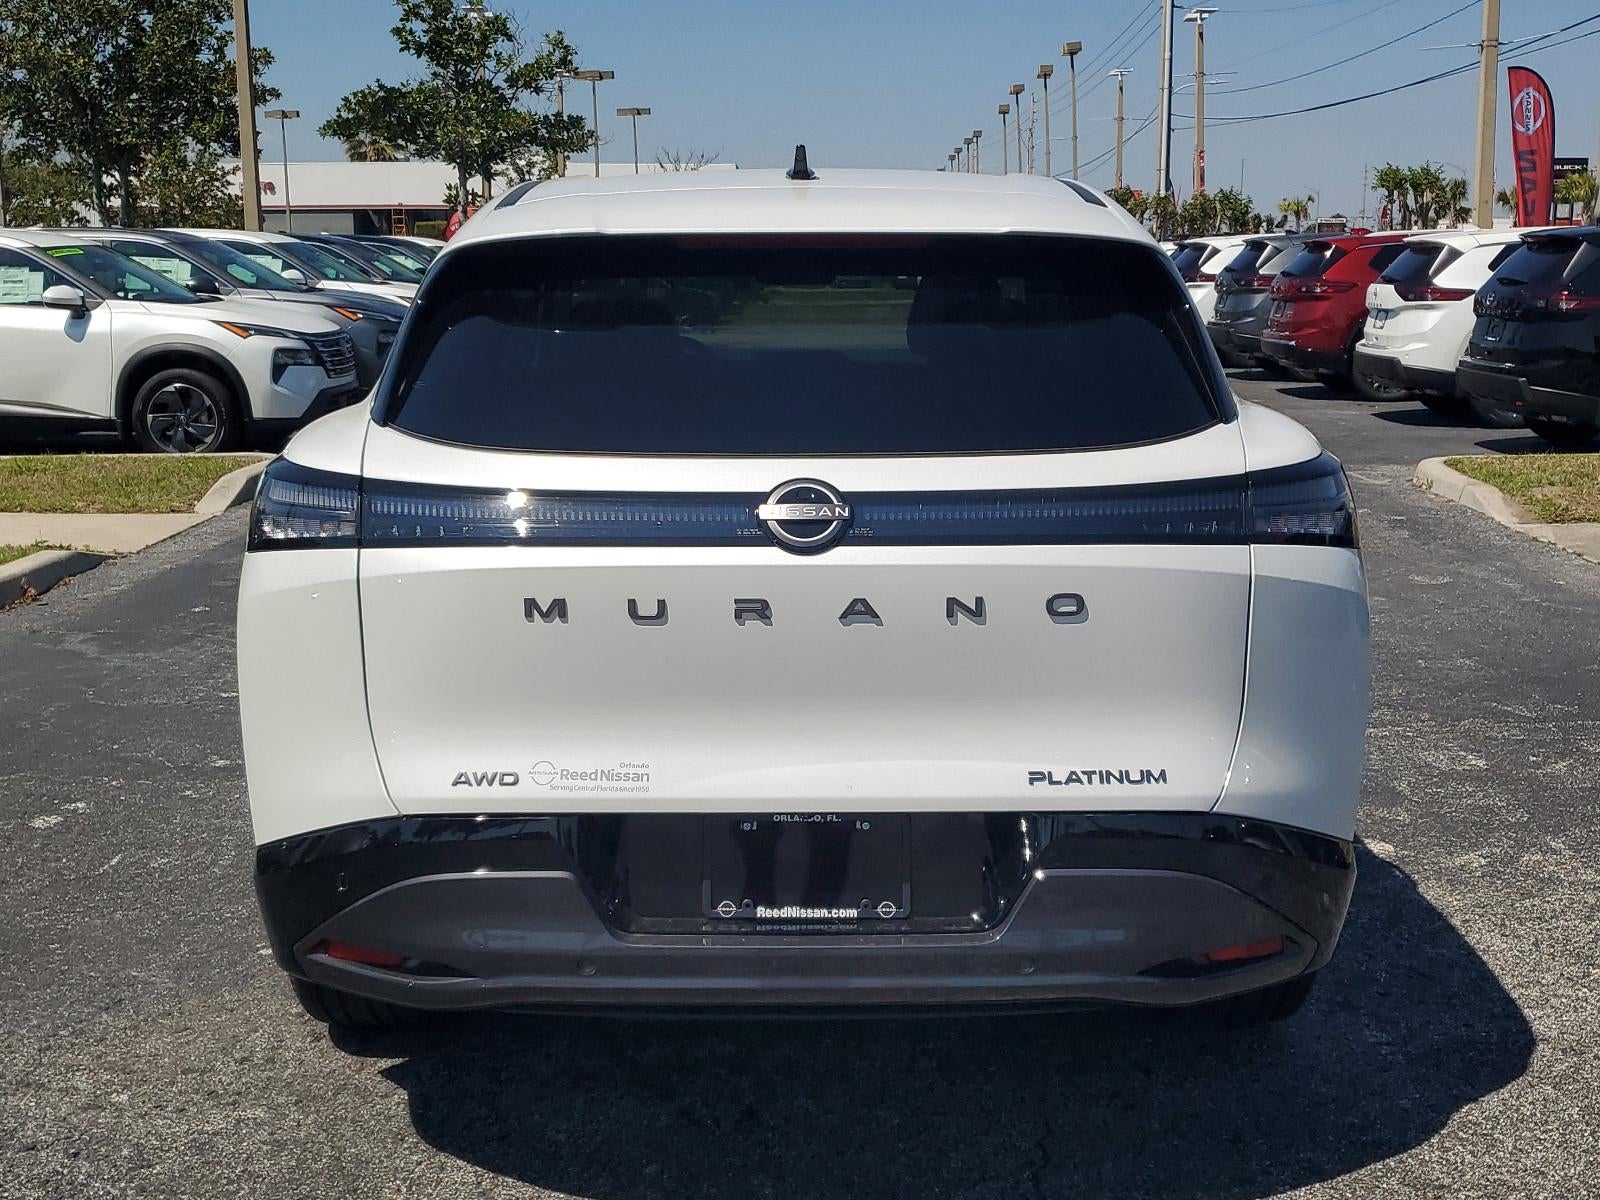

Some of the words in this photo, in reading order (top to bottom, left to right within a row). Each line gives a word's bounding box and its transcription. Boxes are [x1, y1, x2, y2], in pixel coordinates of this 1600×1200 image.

[523, 592, 1090, 627] MURANO
[451, 771, 520, 787] AWD
[1028, 768, 1167, 786] PLATINUM
[827, 814, 842, 822] FL.
[756, 905, 858, 918] ReedNissan.com
